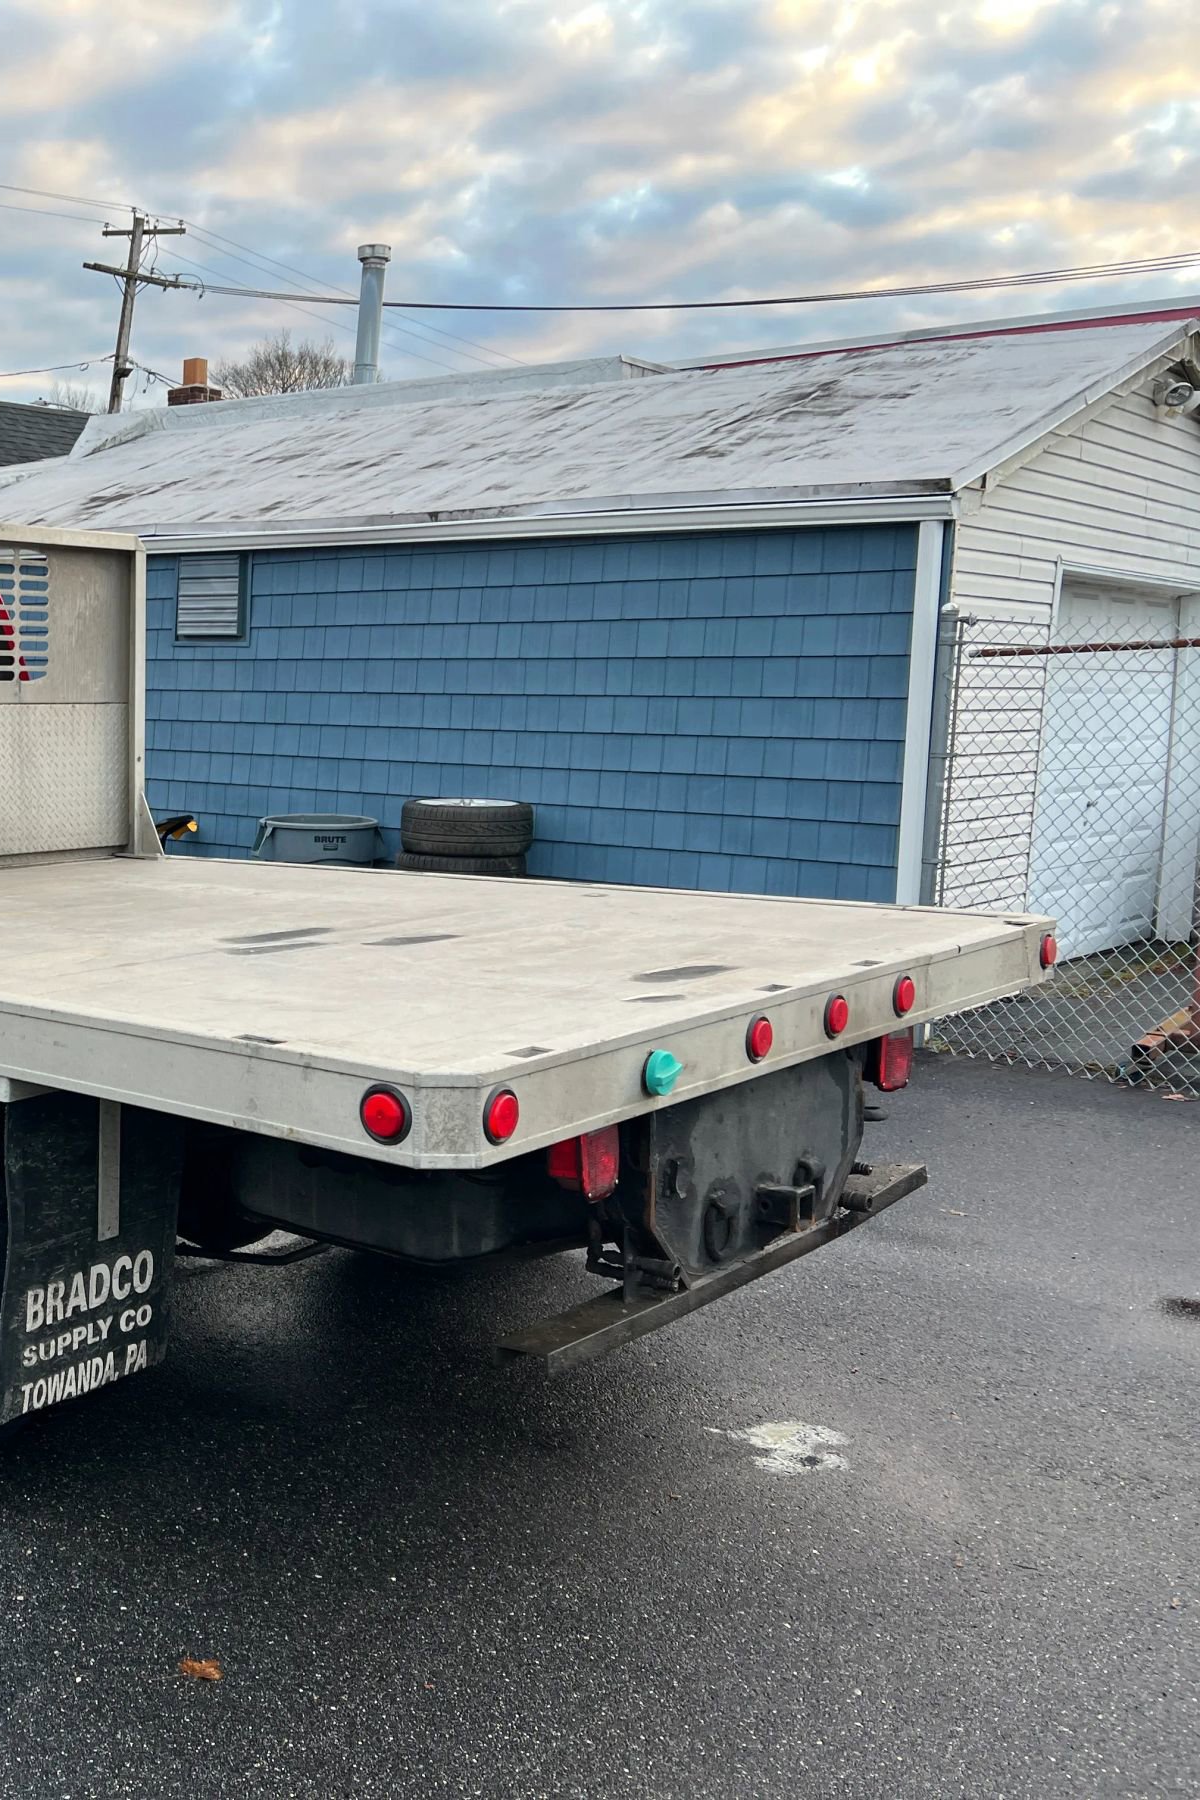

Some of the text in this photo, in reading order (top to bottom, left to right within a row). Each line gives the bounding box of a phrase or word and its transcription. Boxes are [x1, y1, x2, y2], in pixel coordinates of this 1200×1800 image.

[314, 835, 347, 844] BRUTE
[25, 1250, 154, 1333] BRADCO
[22, 1304, 153, 1368] SUPPLY CO
[21, 1339, 147, 1414] TOWANDA, PA
